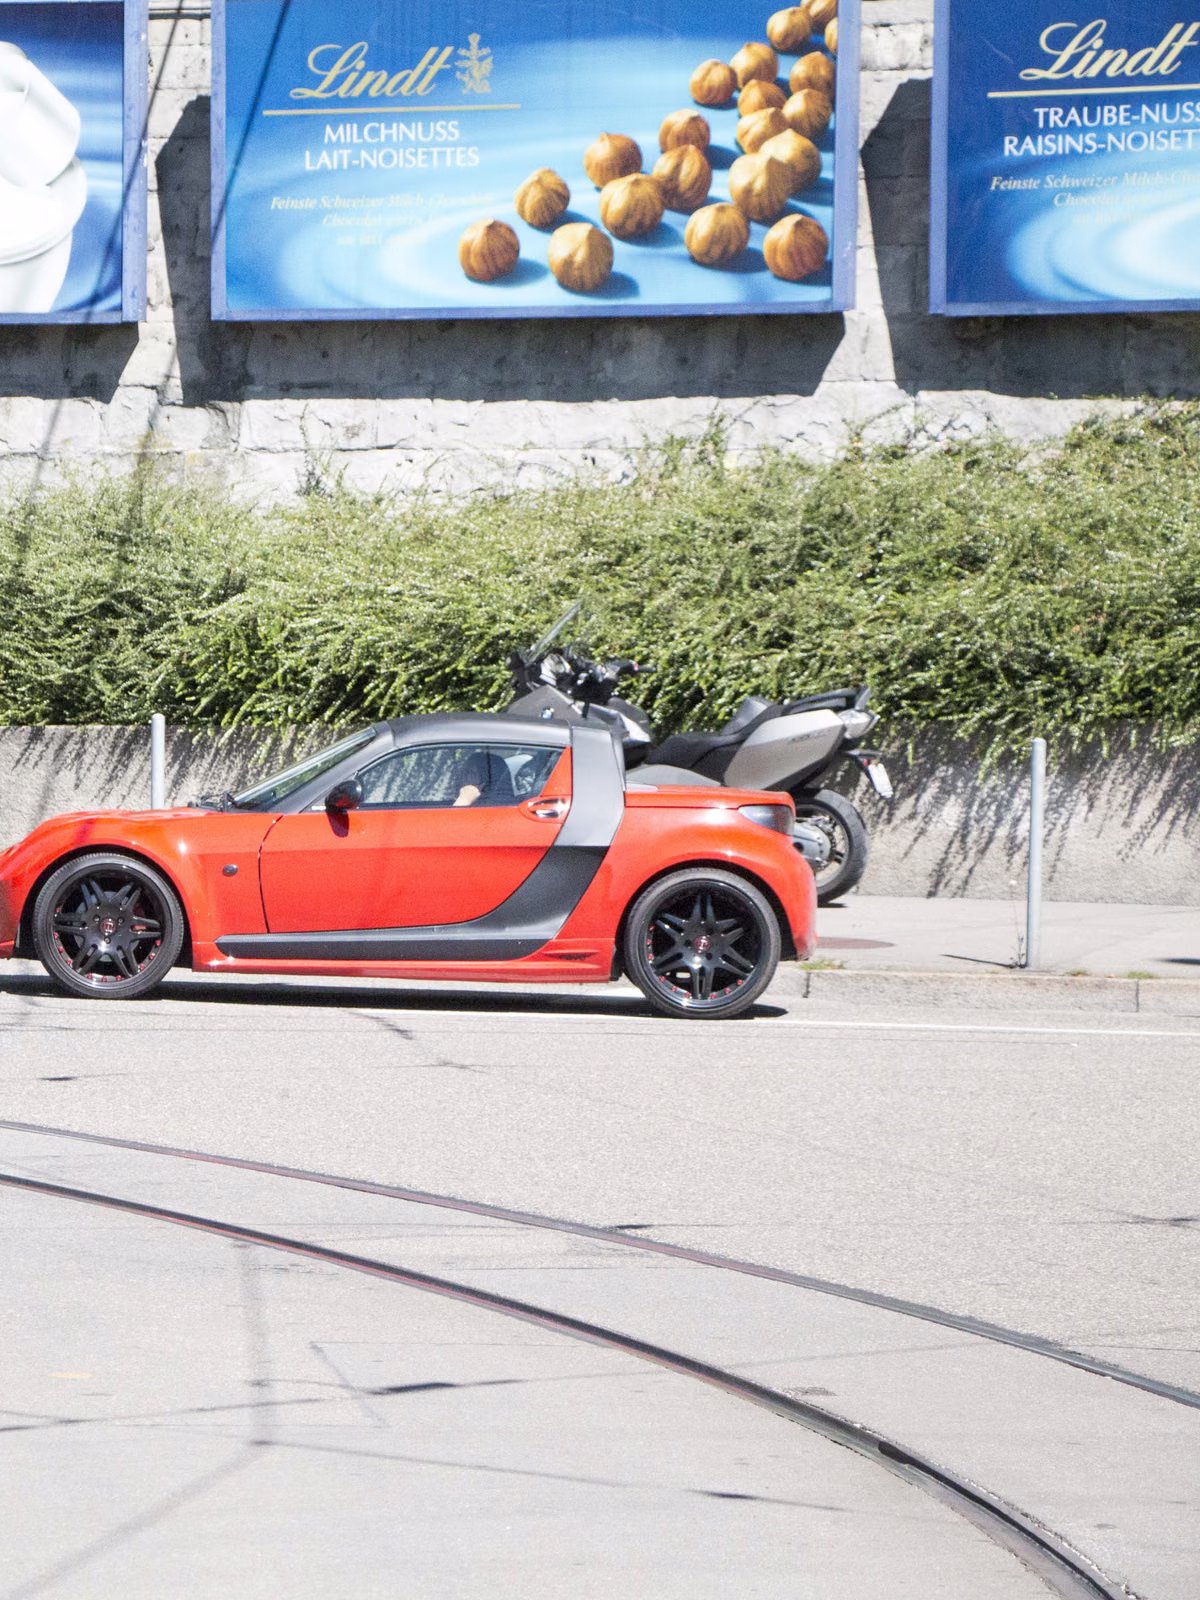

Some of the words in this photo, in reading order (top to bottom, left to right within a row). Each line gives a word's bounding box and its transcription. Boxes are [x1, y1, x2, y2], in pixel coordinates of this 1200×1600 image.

[1019, 19, 1200, 80] Lindt
[289, 41, 455, 99] Lindt
[324, 120, 460, 144] MILCHNUSS
[305, 146, 480, 171] LAIT-NOISETTES
[990, 176, 1040, 191] Feinste
[1044, 174, 1118, 189] Schweizer
[270, 196, 317, 211] Feinste
[319, 194, 385, 209] Schweizer
